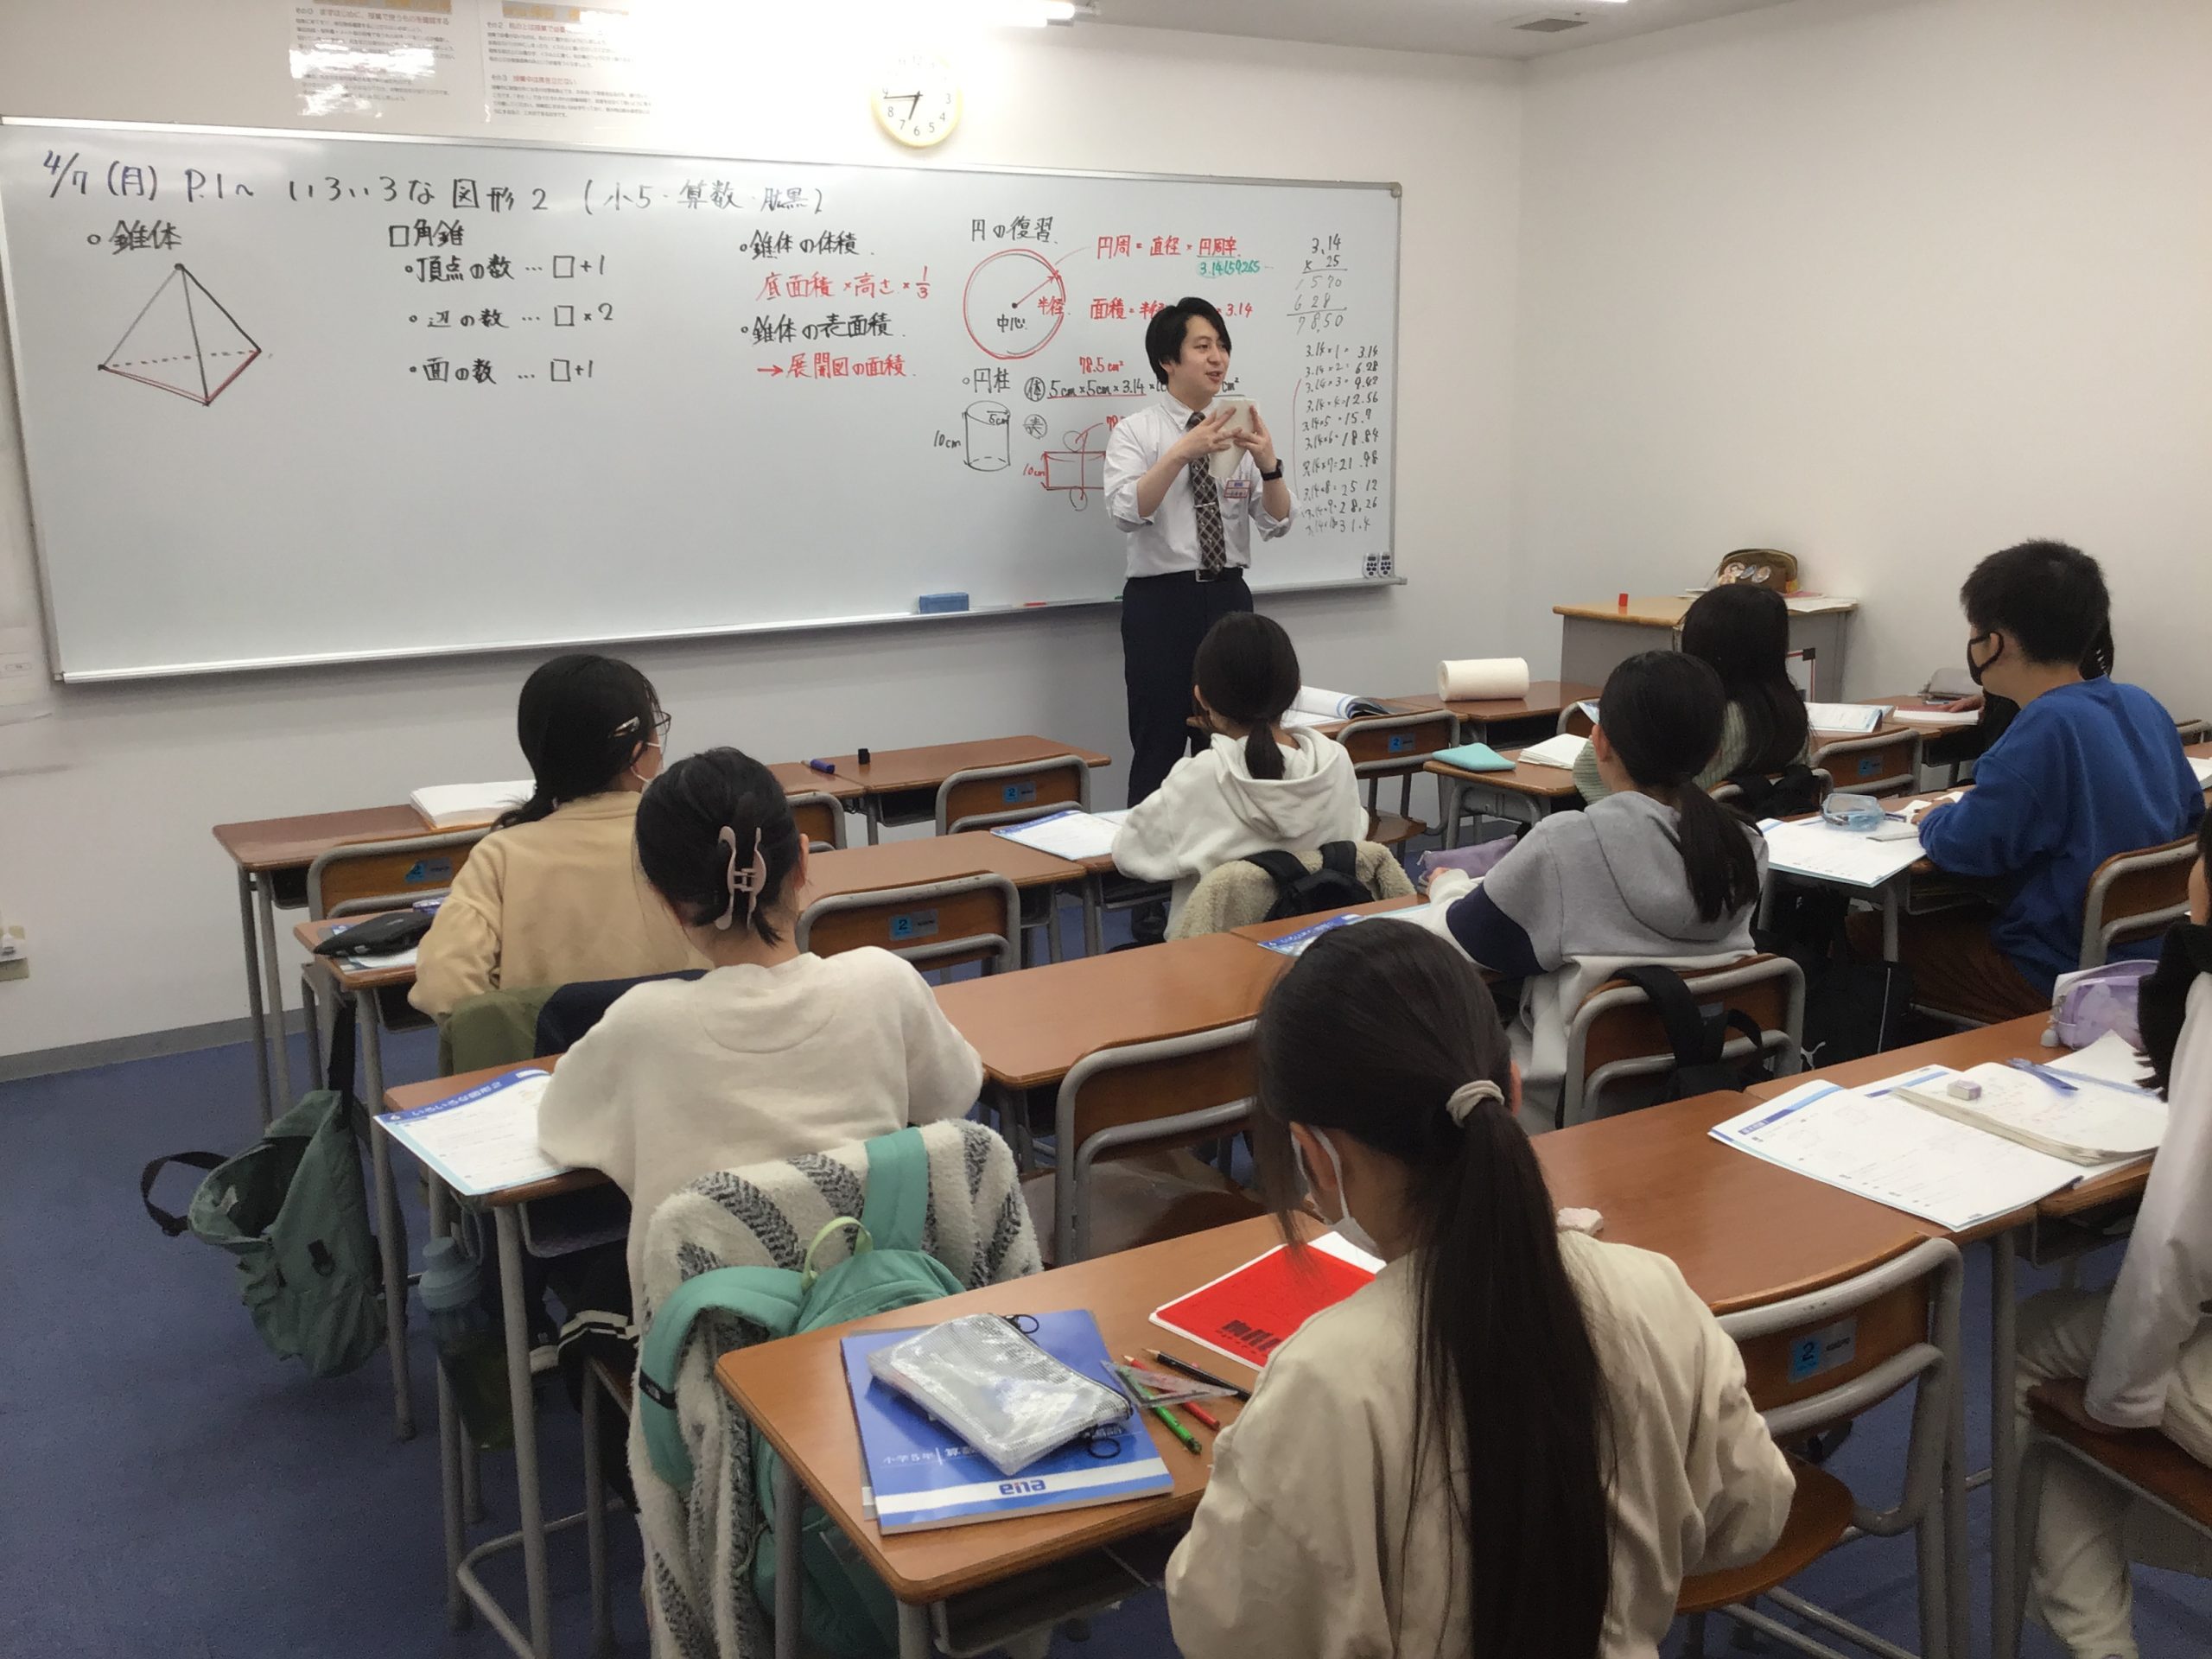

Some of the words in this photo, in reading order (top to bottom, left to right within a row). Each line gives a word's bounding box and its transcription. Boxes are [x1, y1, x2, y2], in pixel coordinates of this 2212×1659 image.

[887, 106, 893, 118] 8
[939, 112, 946, 122] 4
[899, 119, 906, 130] 7
[928, 122, 935, 133] 5
[913, 125, 920, 137] 6
[1802, 1342, 1815, 1362] 2
[999, 1478, 1046, 1496] ena
